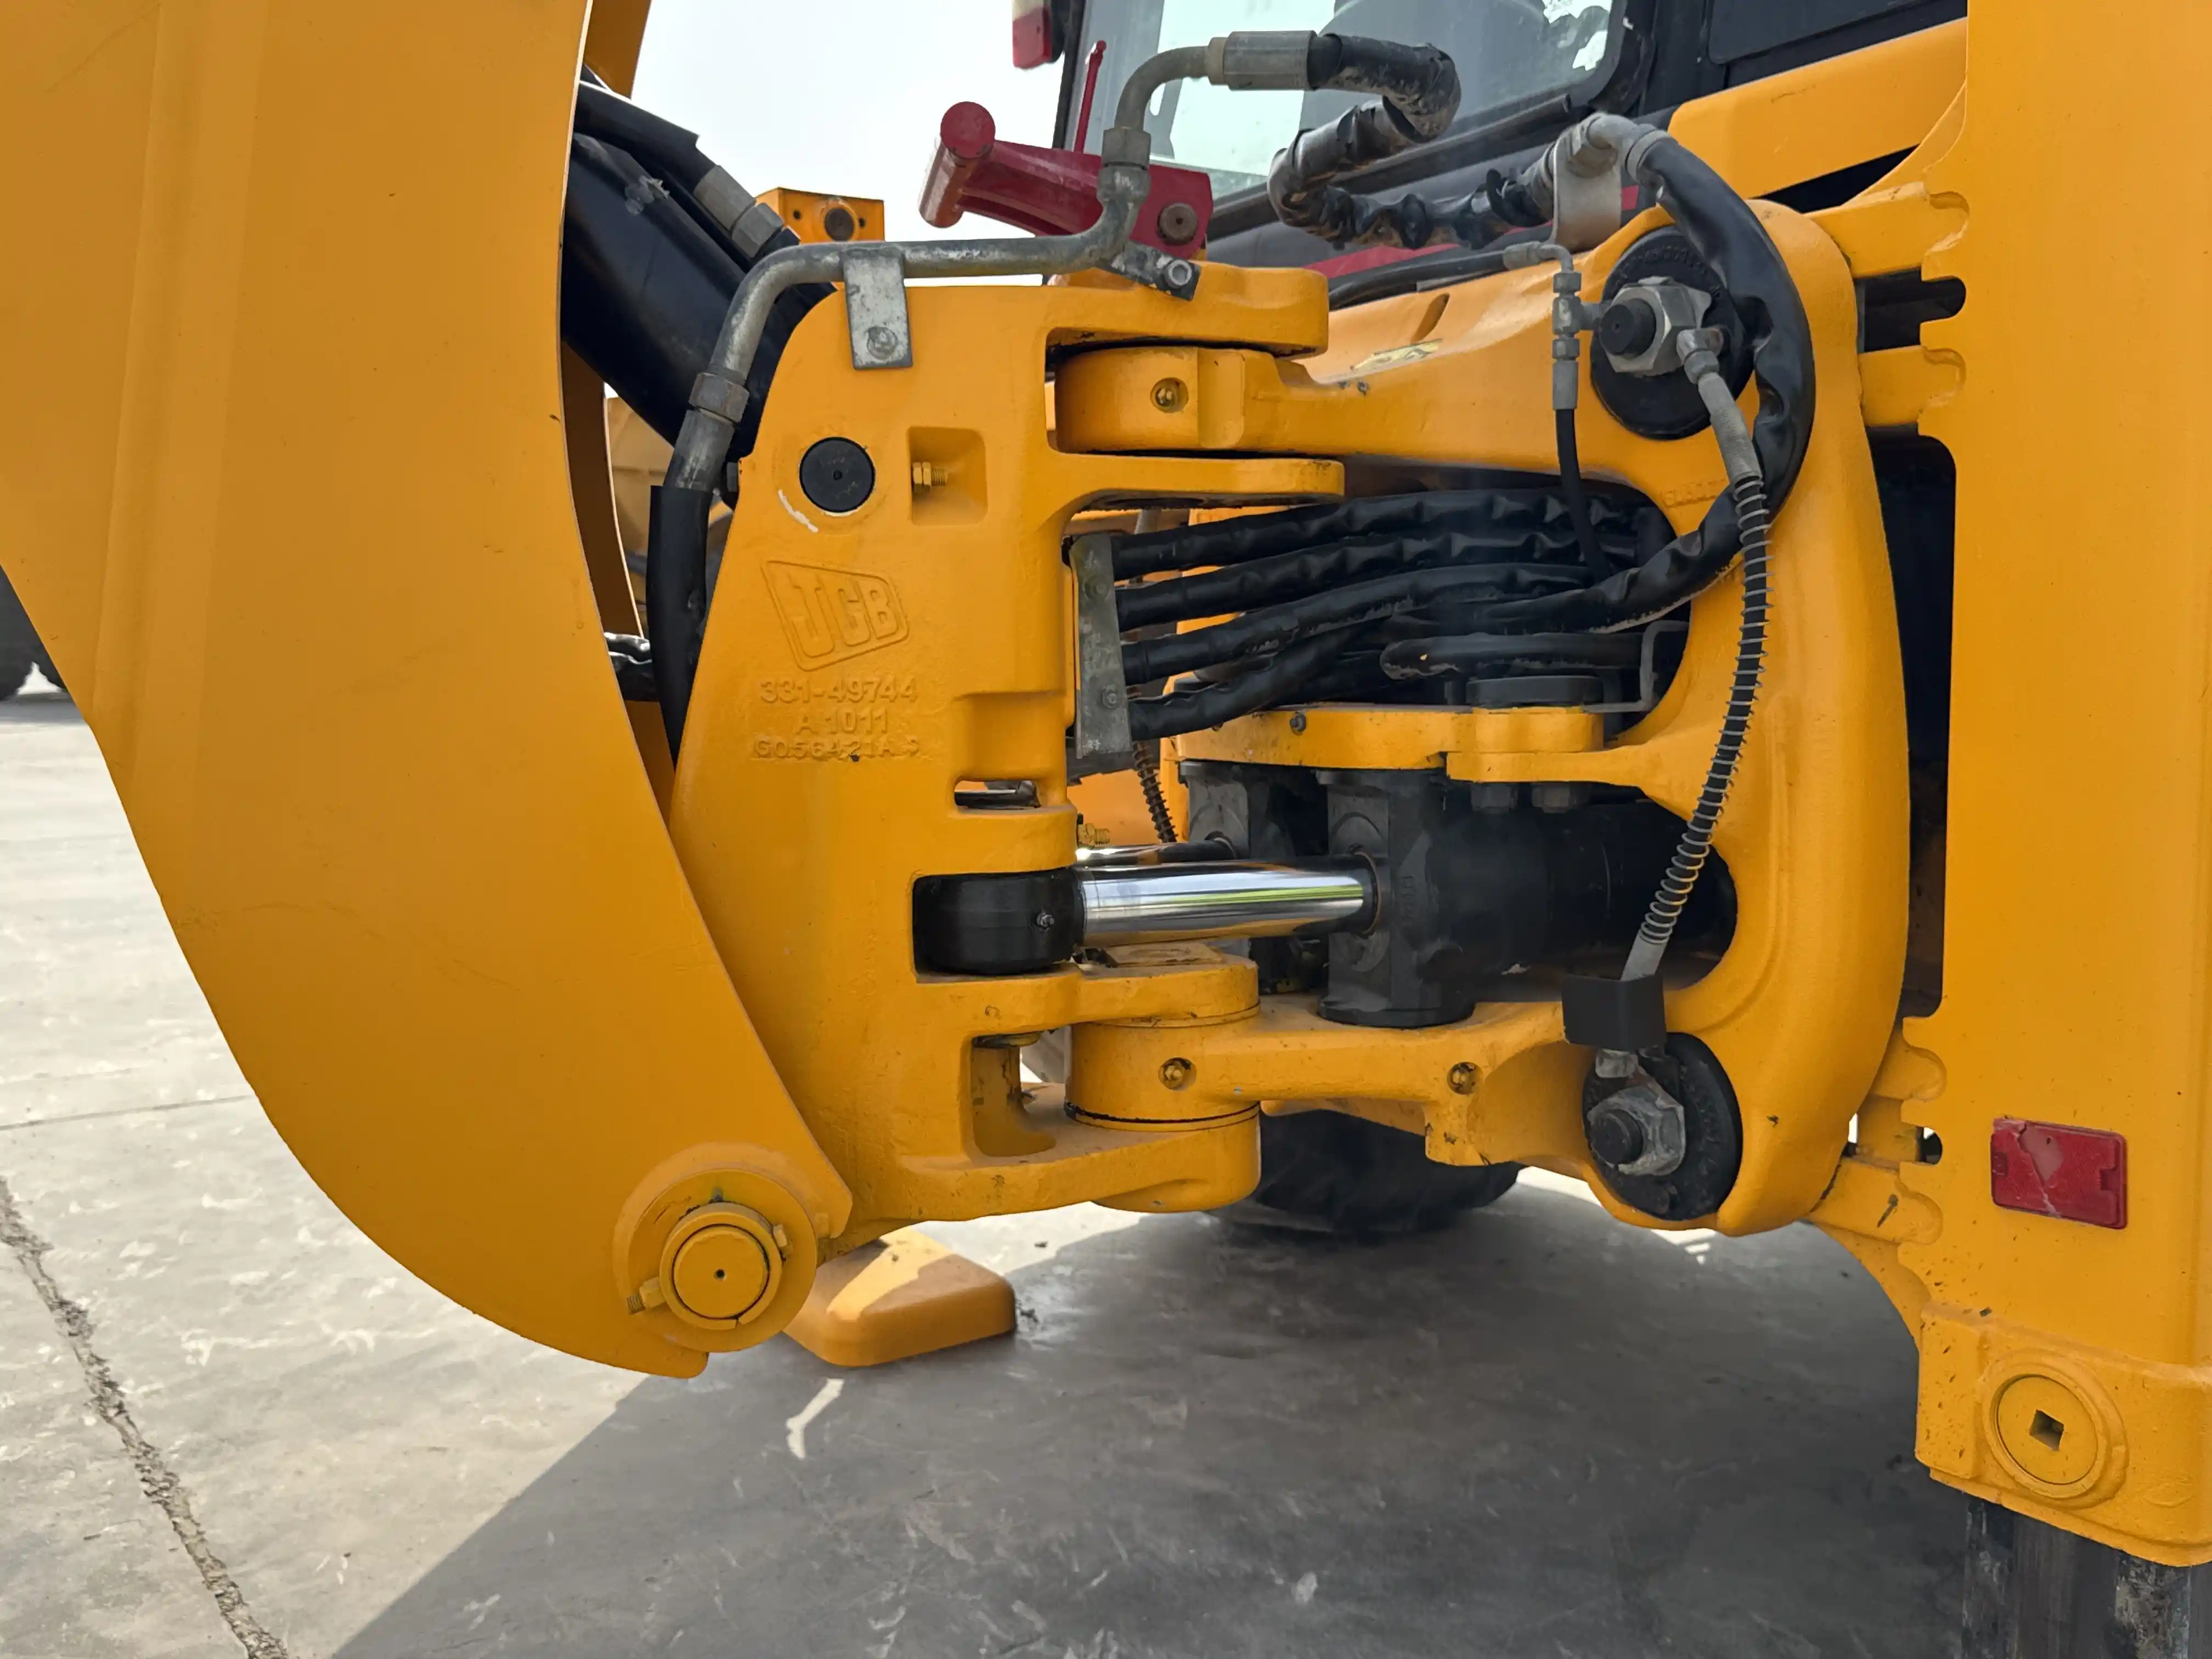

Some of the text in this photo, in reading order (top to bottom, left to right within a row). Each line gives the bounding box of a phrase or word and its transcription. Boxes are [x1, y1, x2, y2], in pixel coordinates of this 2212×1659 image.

[787, 573, 900, 658] JCB
[760, 675, 919, 704] 331-49744
[793, 707, 889, 736] A 1011
